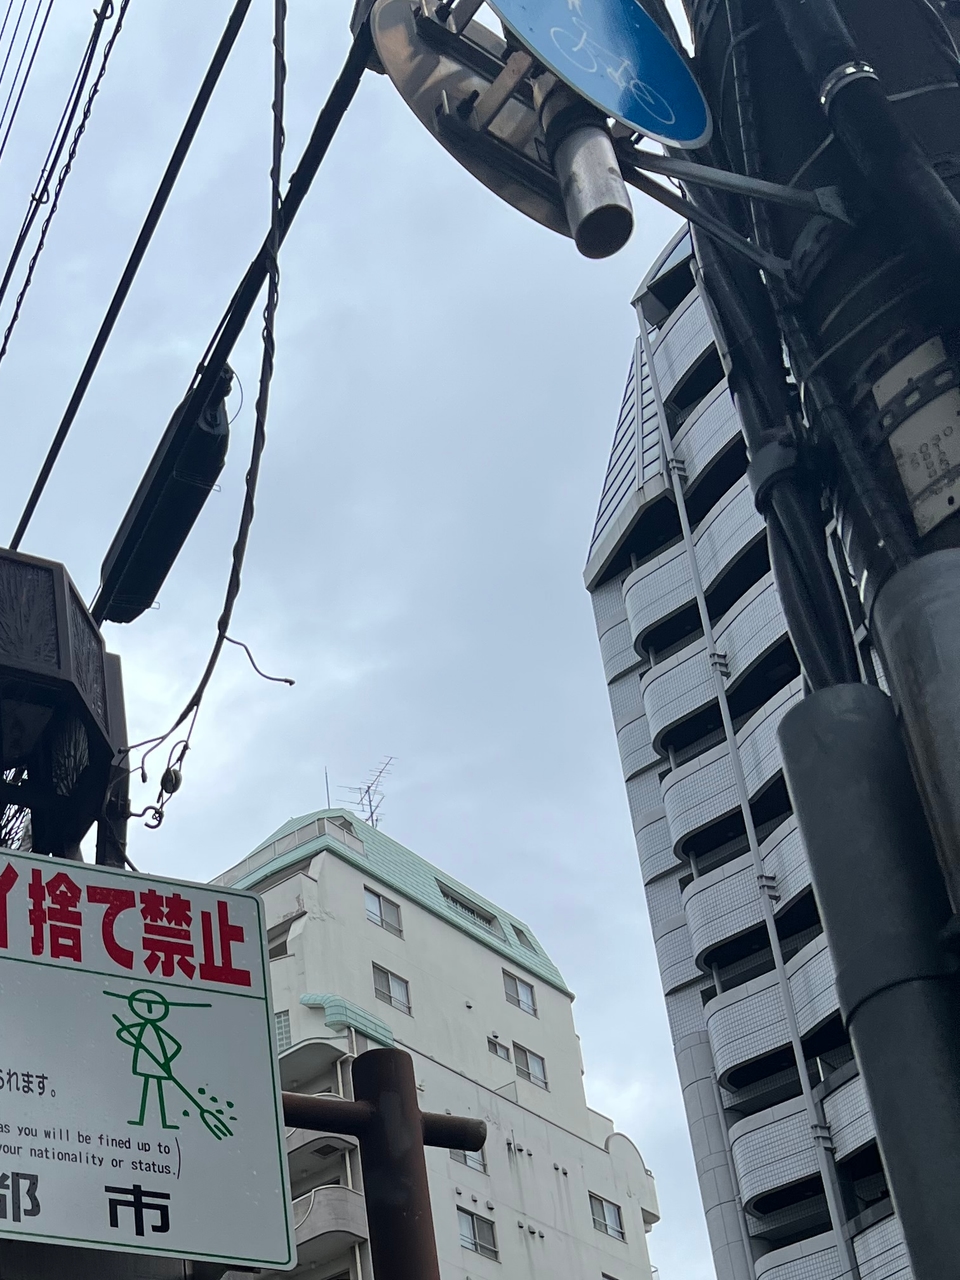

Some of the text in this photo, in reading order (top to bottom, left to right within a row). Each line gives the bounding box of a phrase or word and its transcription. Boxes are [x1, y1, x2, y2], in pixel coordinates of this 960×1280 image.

[17, 1126, 38, 1137] you
[44, 1128, 70, 1142] will
[78, 1131, 91, 1144] be
[98, 1134, 131, 1150] fined
[137, 1142, 151, 1152] up
[157, 1142, 171, 1155] to
[30, 1147, 104, 1168] nationality
[111, 1158, 124, 1168] or
